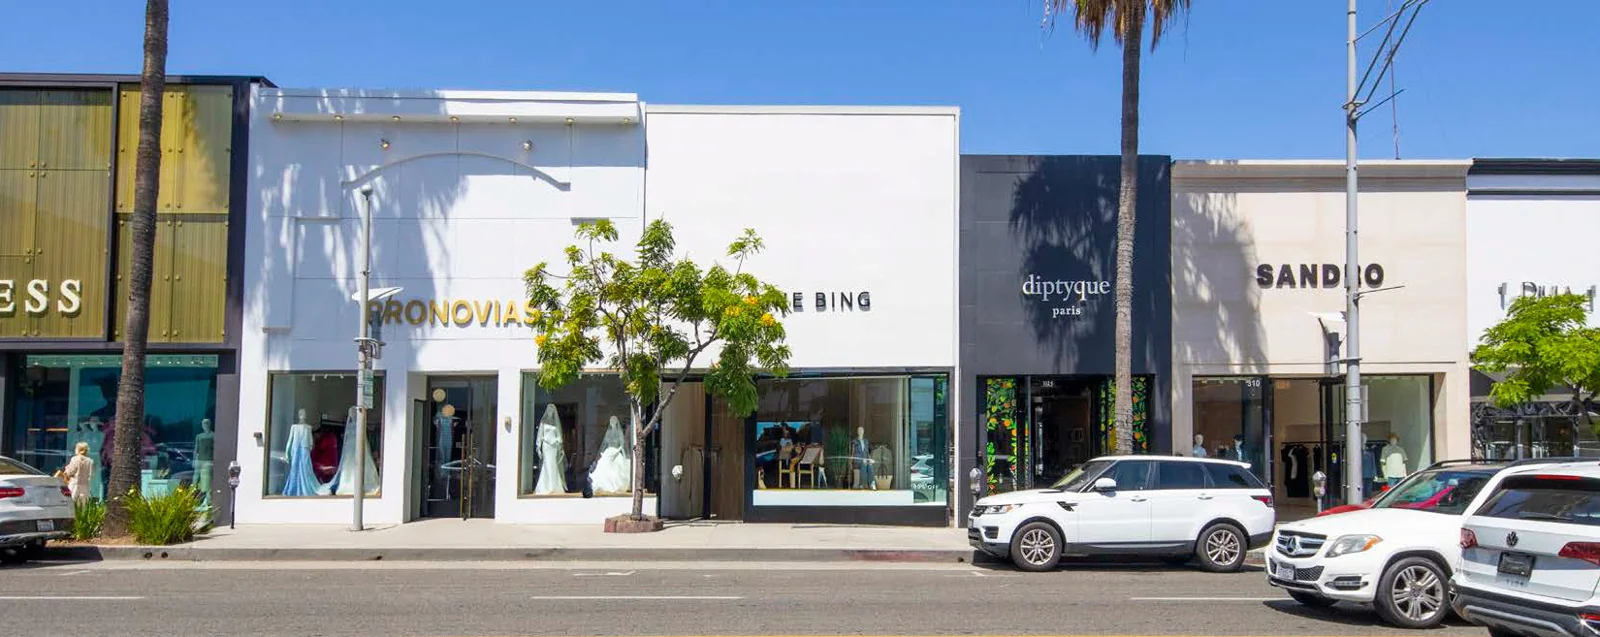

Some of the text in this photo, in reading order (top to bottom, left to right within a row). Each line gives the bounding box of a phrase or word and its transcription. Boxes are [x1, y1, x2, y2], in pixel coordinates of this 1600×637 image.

[1022, 273, 1111, 302] diptyque
[815, 291, 871, 309] BING
[1052, 305, 1082, 318] paris
